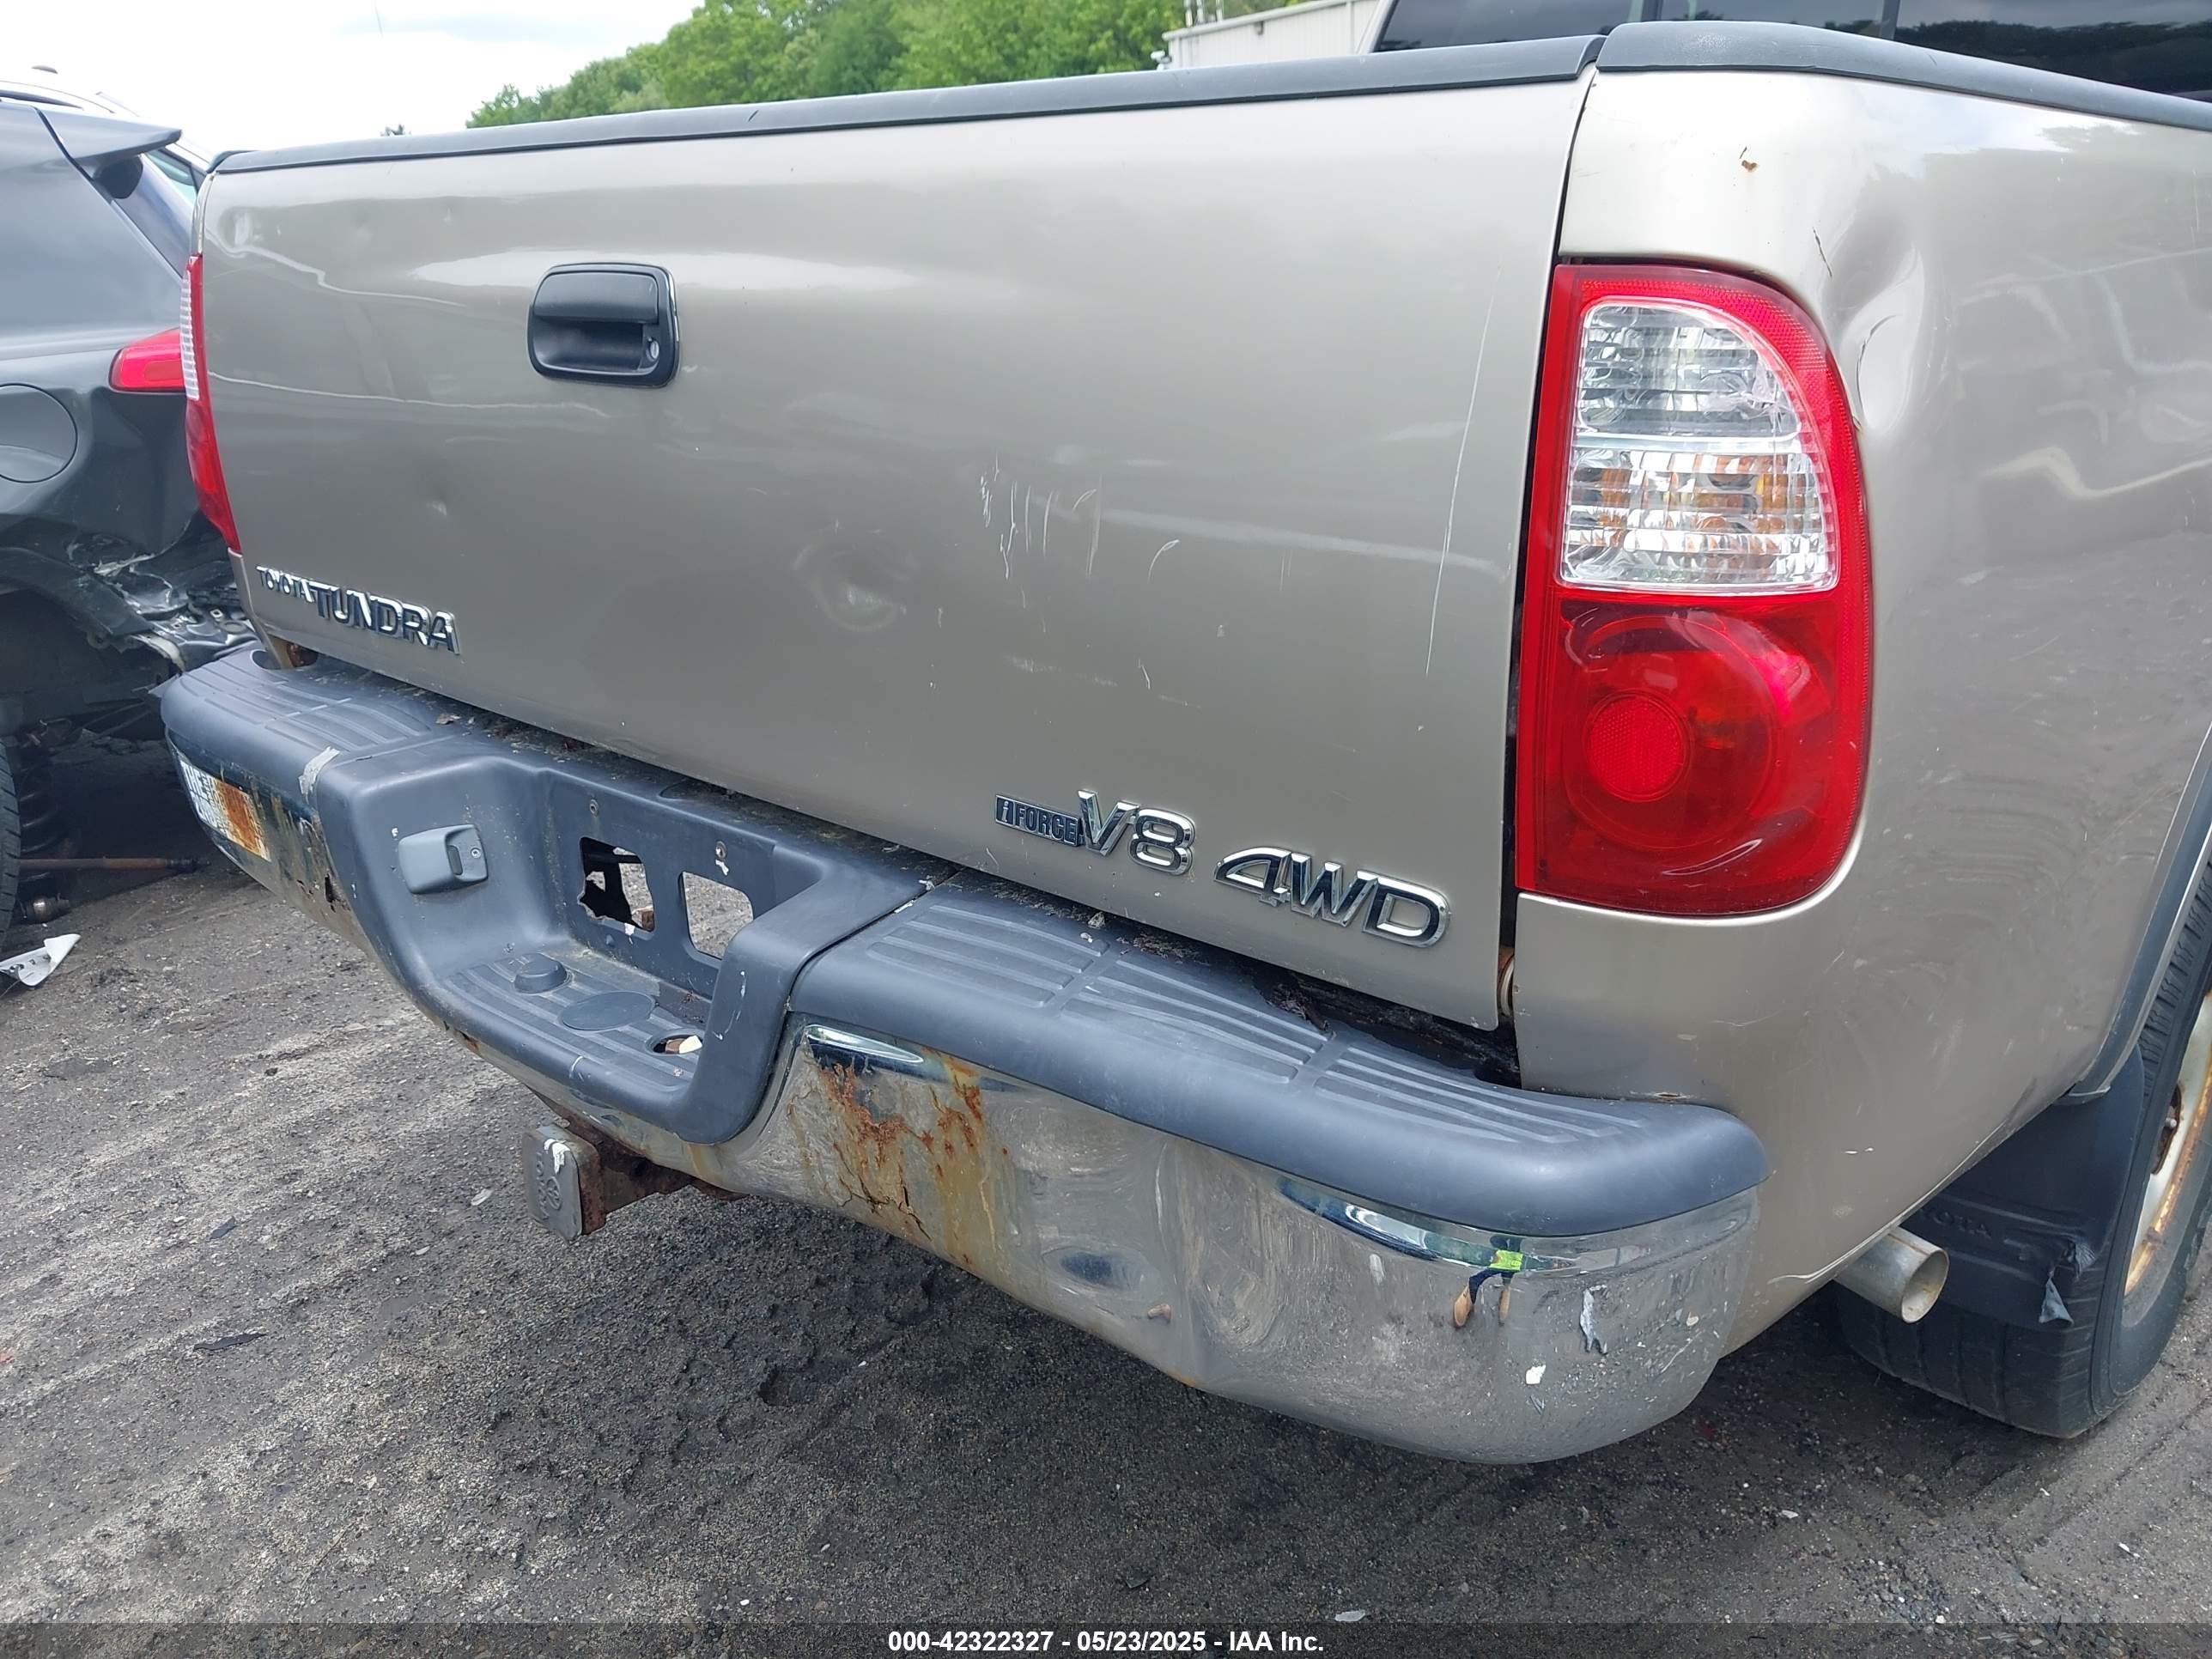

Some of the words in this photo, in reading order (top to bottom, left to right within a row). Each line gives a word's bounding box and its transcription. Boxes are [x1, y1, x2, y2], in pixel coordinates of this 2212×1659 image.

[256, 565, 315, 604] TOYOTA
[308, 580, 461, 656] TUNDRA
[1077, 788, 1195, 876] V8
[1212, 845, 1453, 949] 4WD
